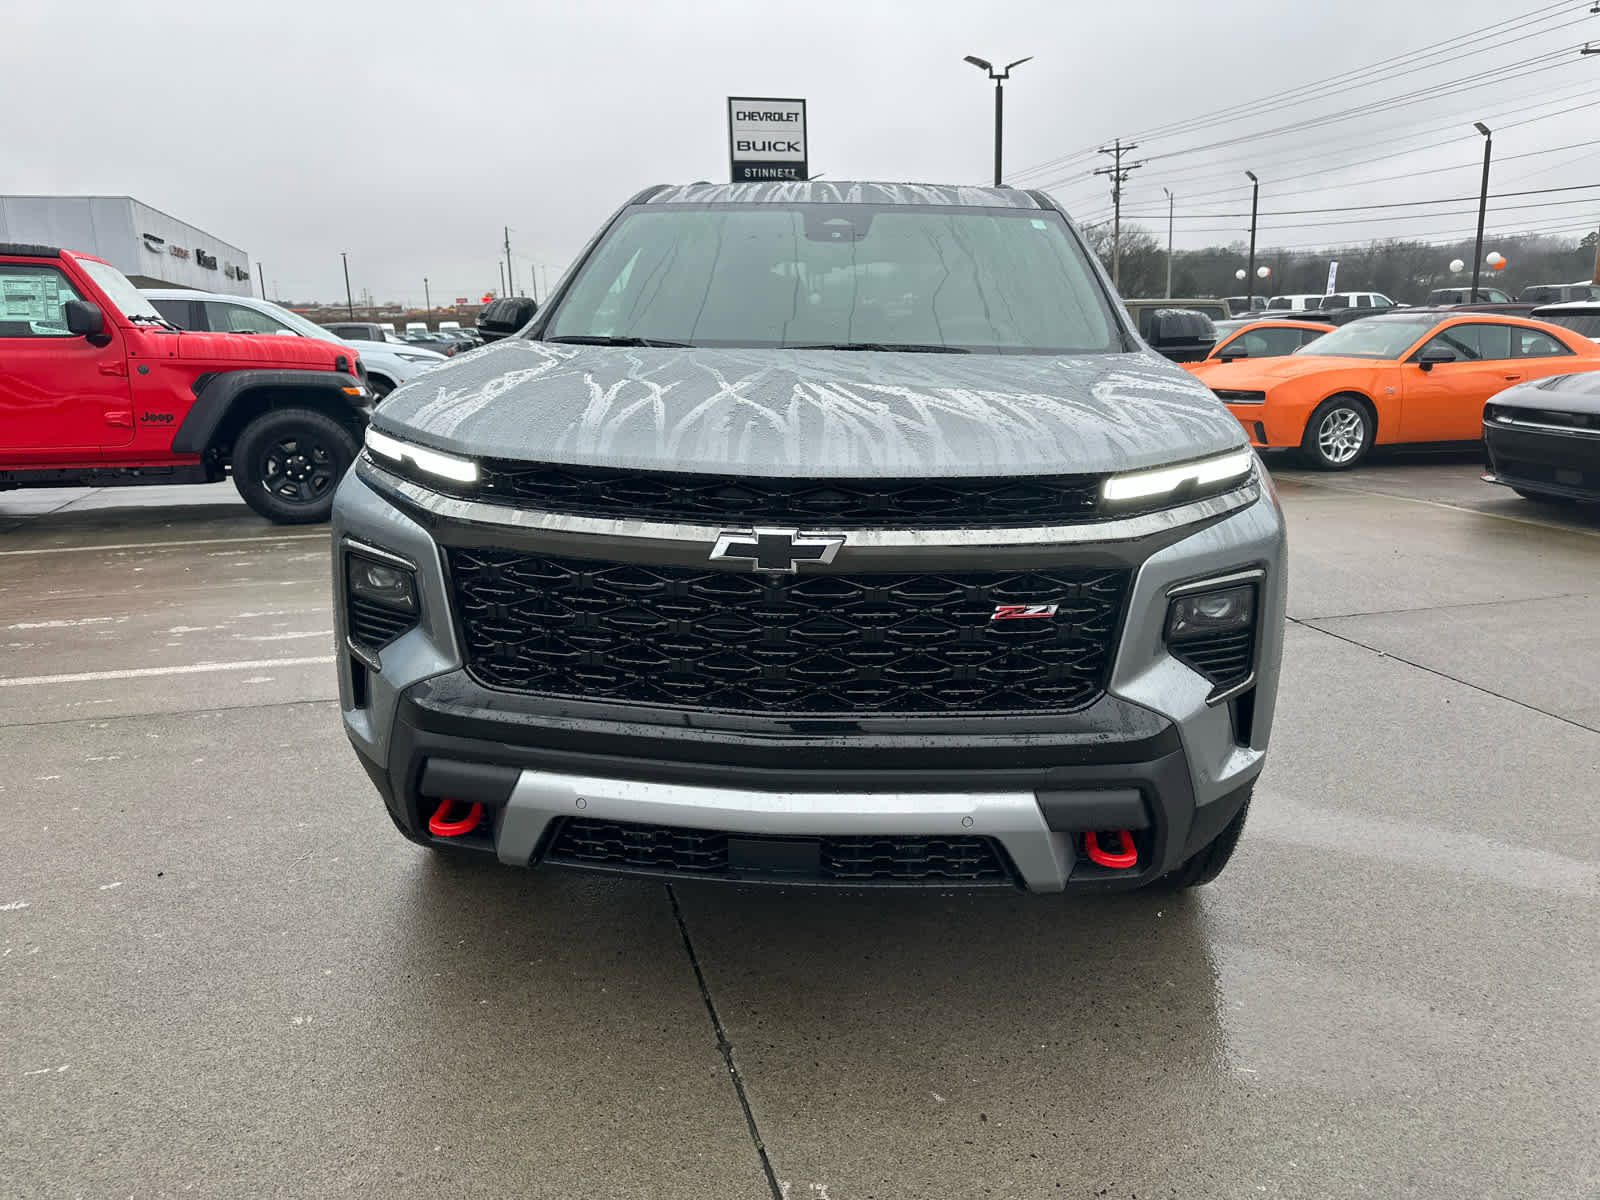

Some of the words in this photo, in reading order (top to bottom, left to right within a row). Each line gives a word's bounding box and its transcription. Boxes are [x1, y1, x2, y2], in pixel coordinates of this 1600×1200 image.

[736, 111, 800, 122] CHEVROLET
[736, 140, 801, 152] BUICK
[744, 168, 796, 178] STINNETT
[140, 411, 174, 423] Jeep
